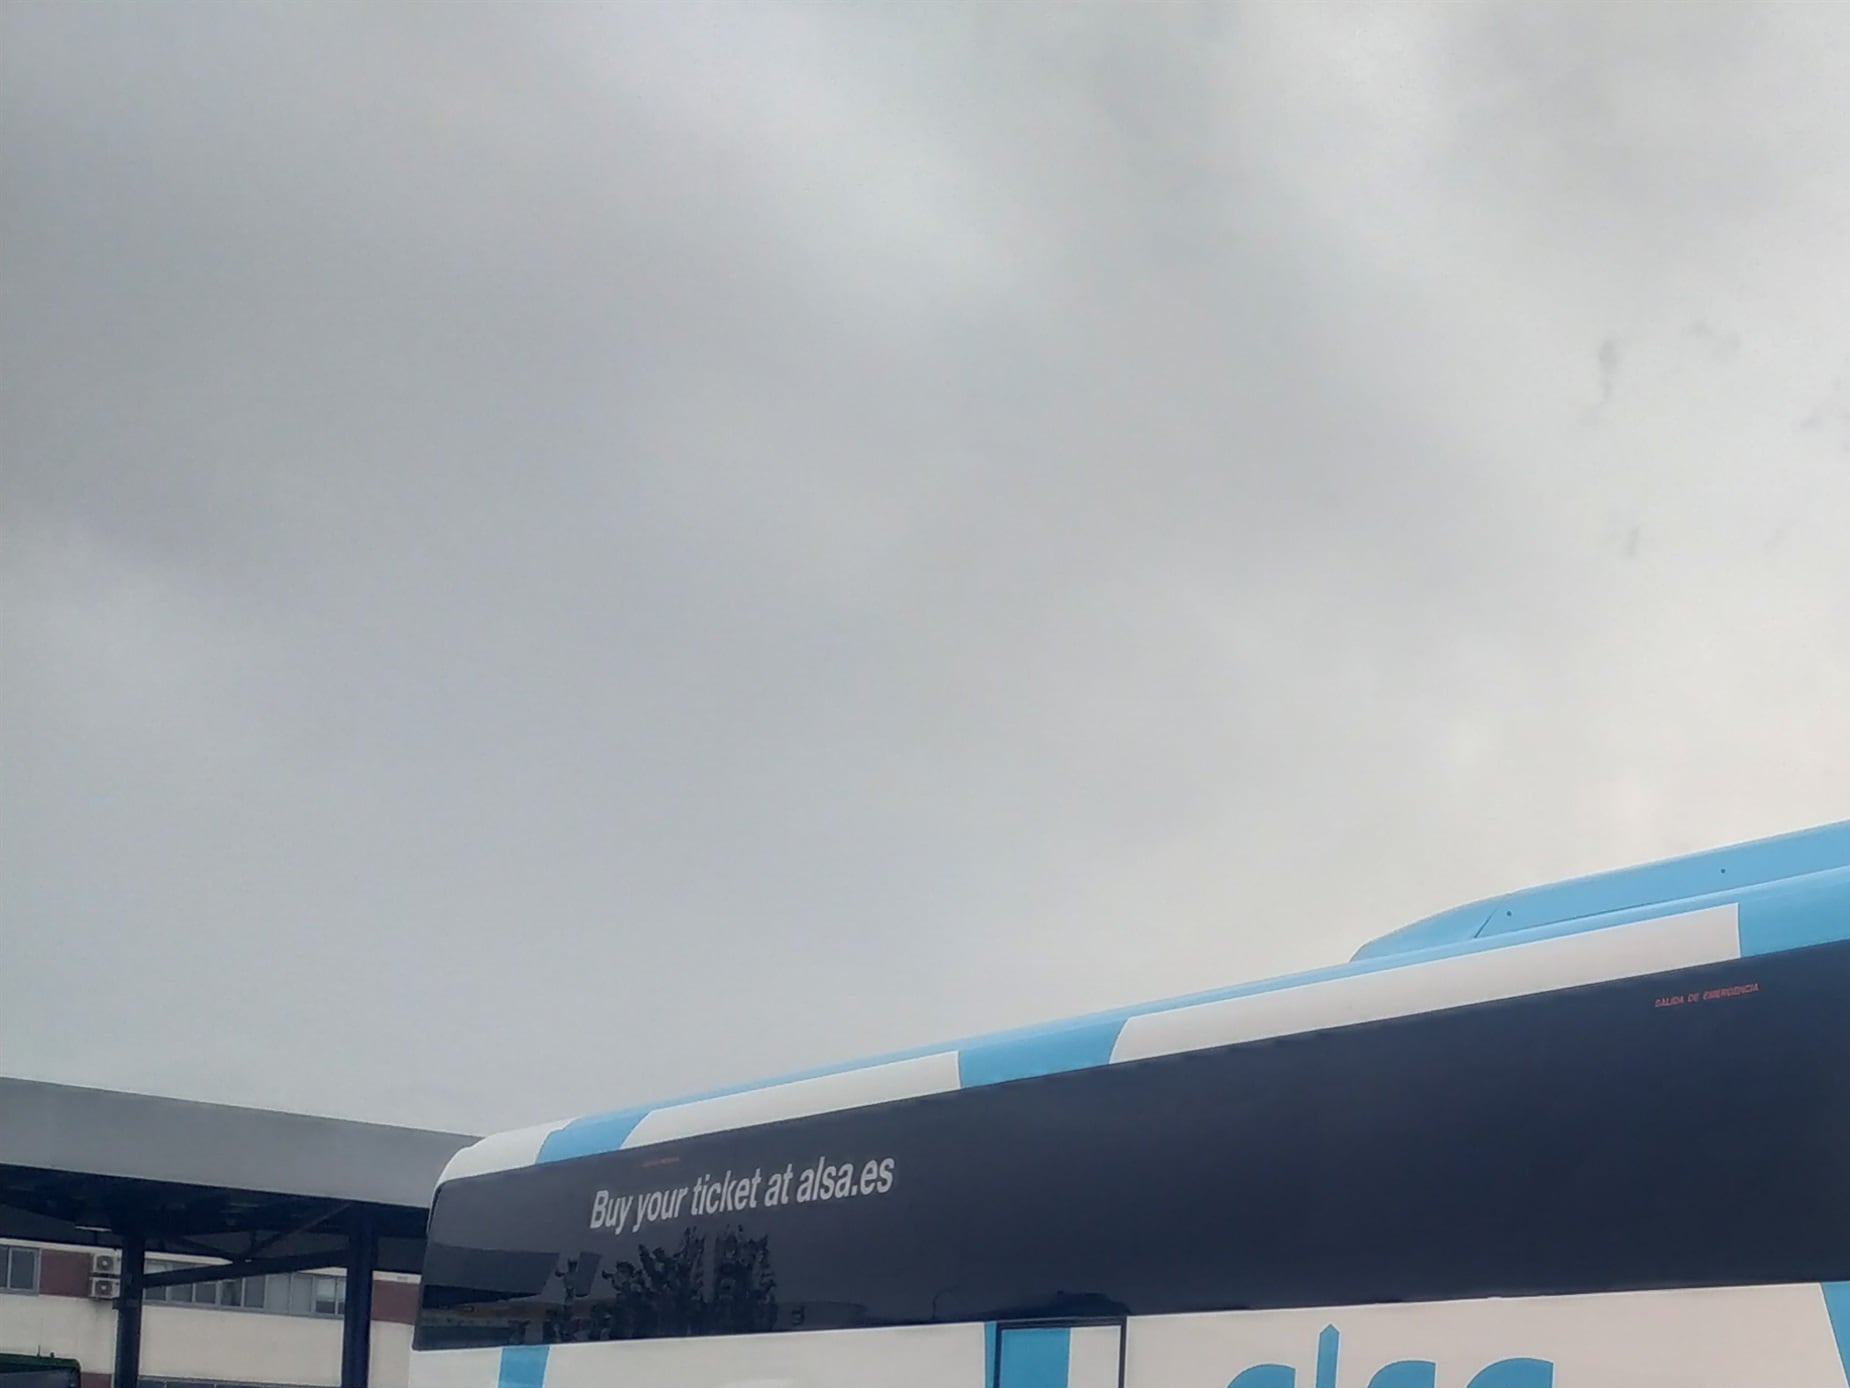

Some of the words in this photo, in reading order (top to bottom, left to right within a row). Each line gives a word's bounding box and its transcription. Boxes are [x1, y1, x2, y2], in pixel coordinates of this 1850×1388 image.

[589, 1189, 634, 1235] Buy
[631, 1185, 689, 1232] your
[690, 1168, 762, 1216] ticket
[764, 1162, 794, 1208] at
[796, 1156, 896, 1204] alsa.es
